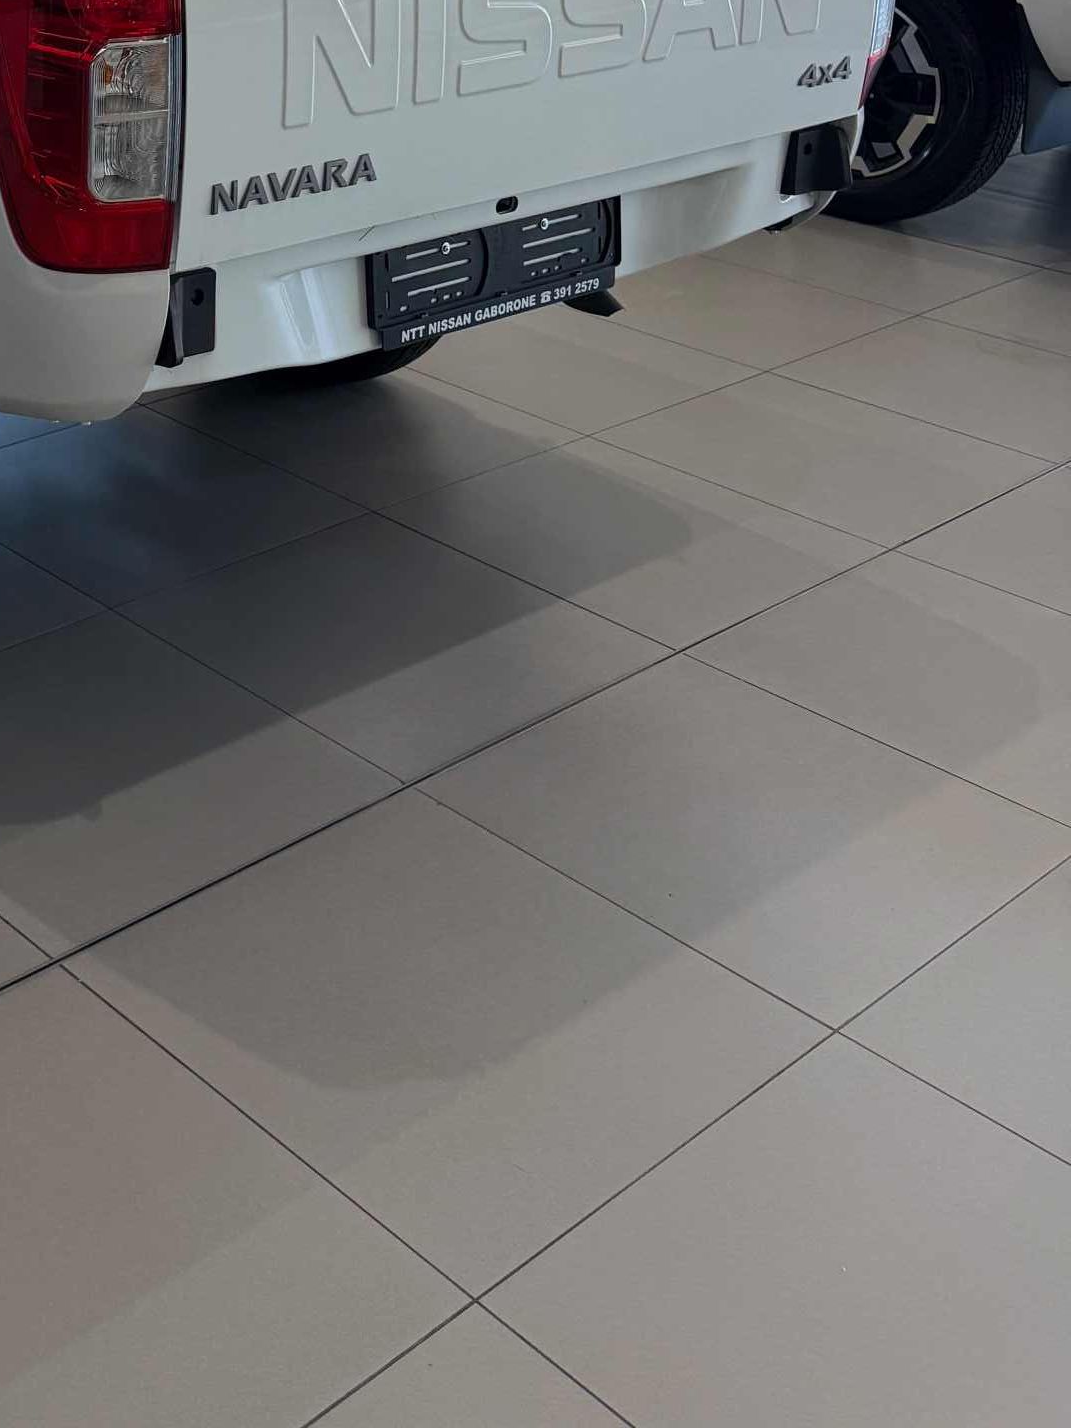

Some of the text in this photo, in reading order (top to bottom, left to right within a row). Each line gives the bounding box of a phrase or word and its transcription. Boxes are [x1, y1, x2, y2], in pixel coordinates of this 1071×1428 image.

[797, 55, 852, 87] 4x4
[209, 152, 377, 215] NAVARA
[401, 278, 600, 343] NTT NISSAN GABORONE 391 2579
